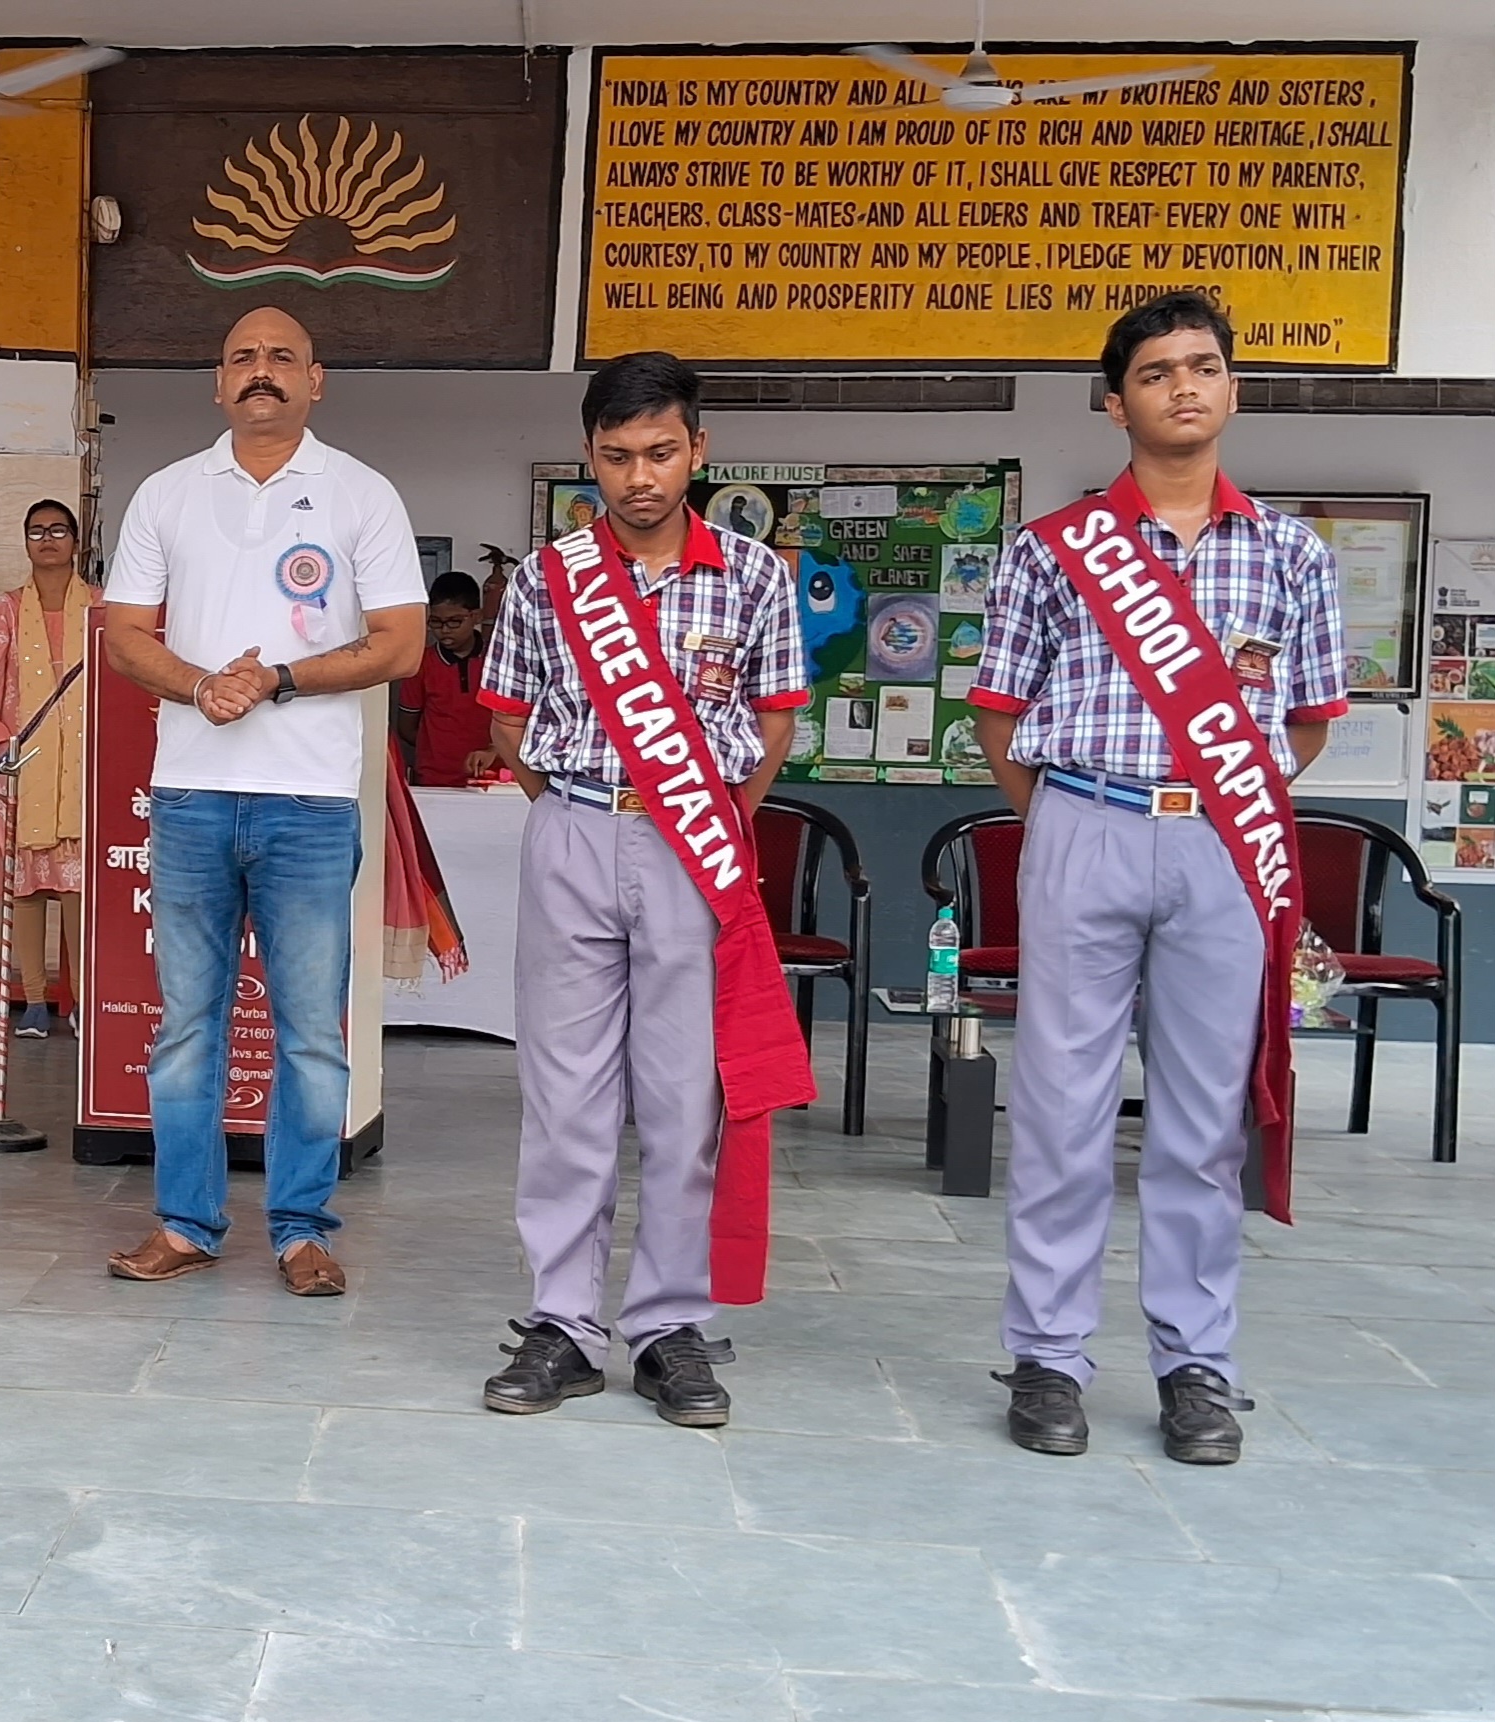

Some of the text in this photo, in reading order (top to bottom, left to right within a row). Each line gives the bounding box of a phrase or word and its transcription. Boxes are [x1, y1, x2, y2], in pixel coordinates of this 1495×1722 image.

[679, 81, 697, 105] IS
[708, 81, 740, 106] MY
[746, 80, 839, 106] COUNTRY
[848, 80, 887, 105] AND
[1121, 80, 1220, 105] BROTHERS
[1229, 80, 1269, 105] AND
[619, 121, 664, 146] LOVE
[675, 121, 701, 146] MY
[708, 120, 795, 146] COUNTRY
[800, 120, 838, 146] AND
[858, 121, 886, 145] AM
[896, 120, 954, 145] PROUD
[966, 120, 990, 145] OF
[998, 120, 1026, 145] ITS
[1040, 120, 1082, 145] RICH
[1092, 121, 1132, 145] AND
[1143, 121, 1205, 146] VARIED
[1328, 121, 1392, 147] SHALL
[607, 162, 679, 187] ALWAYS
[686, 161, 749, 186] STRIVE
[761, 161, 784, 186] TO
[796, 162, 818, 186] BE
[828, 161, 904, 186] WORTHY
[913, 161, 937, 186] OF
[991, 161, 1052, 186] SHALL
[1060, 161, 1100, 186] GIVE
[1111, 162, 1196, 187] RESPECT
[1208, 162, 1229, 186] TO
[1239, 162, 1264, 187] MY
[719, 202, 1344, 229] CLASS-MATES AND ALL ELDERS AND TREAT EVERY ONE WITH
[707, 243, 732, 268] TO
[746, 243, 769, 268] MY
[779, 243, 861, 268] COUNTRY
[872, 243, 908, 268] AND
[919, 243, 946, 268] MY
[1059, 244, 1131, 269] PLEDGE
[1144, 244, 1171, 268] MY
[1299, 245, 1318, 269] IN
[1328, 245, 1380, 270] THEIR
[605, 283, 1094, 310] WELL BEING AND PROSPERITY ALONE LIES MY
[1245, 323, 1273, 345] JAI
[774, 466, 824, 482] HOUSE
[829, 519, 888, 539] GREEN
[841, 544, 932, 563] AND SAFE
[869, 569, 930, 588] PLANET
[1061, 508, 1202, 695] SCHOOL
[571, 573, 650, 686] VICE
[615, 680, 743, 891] CAPTAIN
[102, 1002, 138, 1014] Haldia
[233, 1006, 268, 1019] Purba
